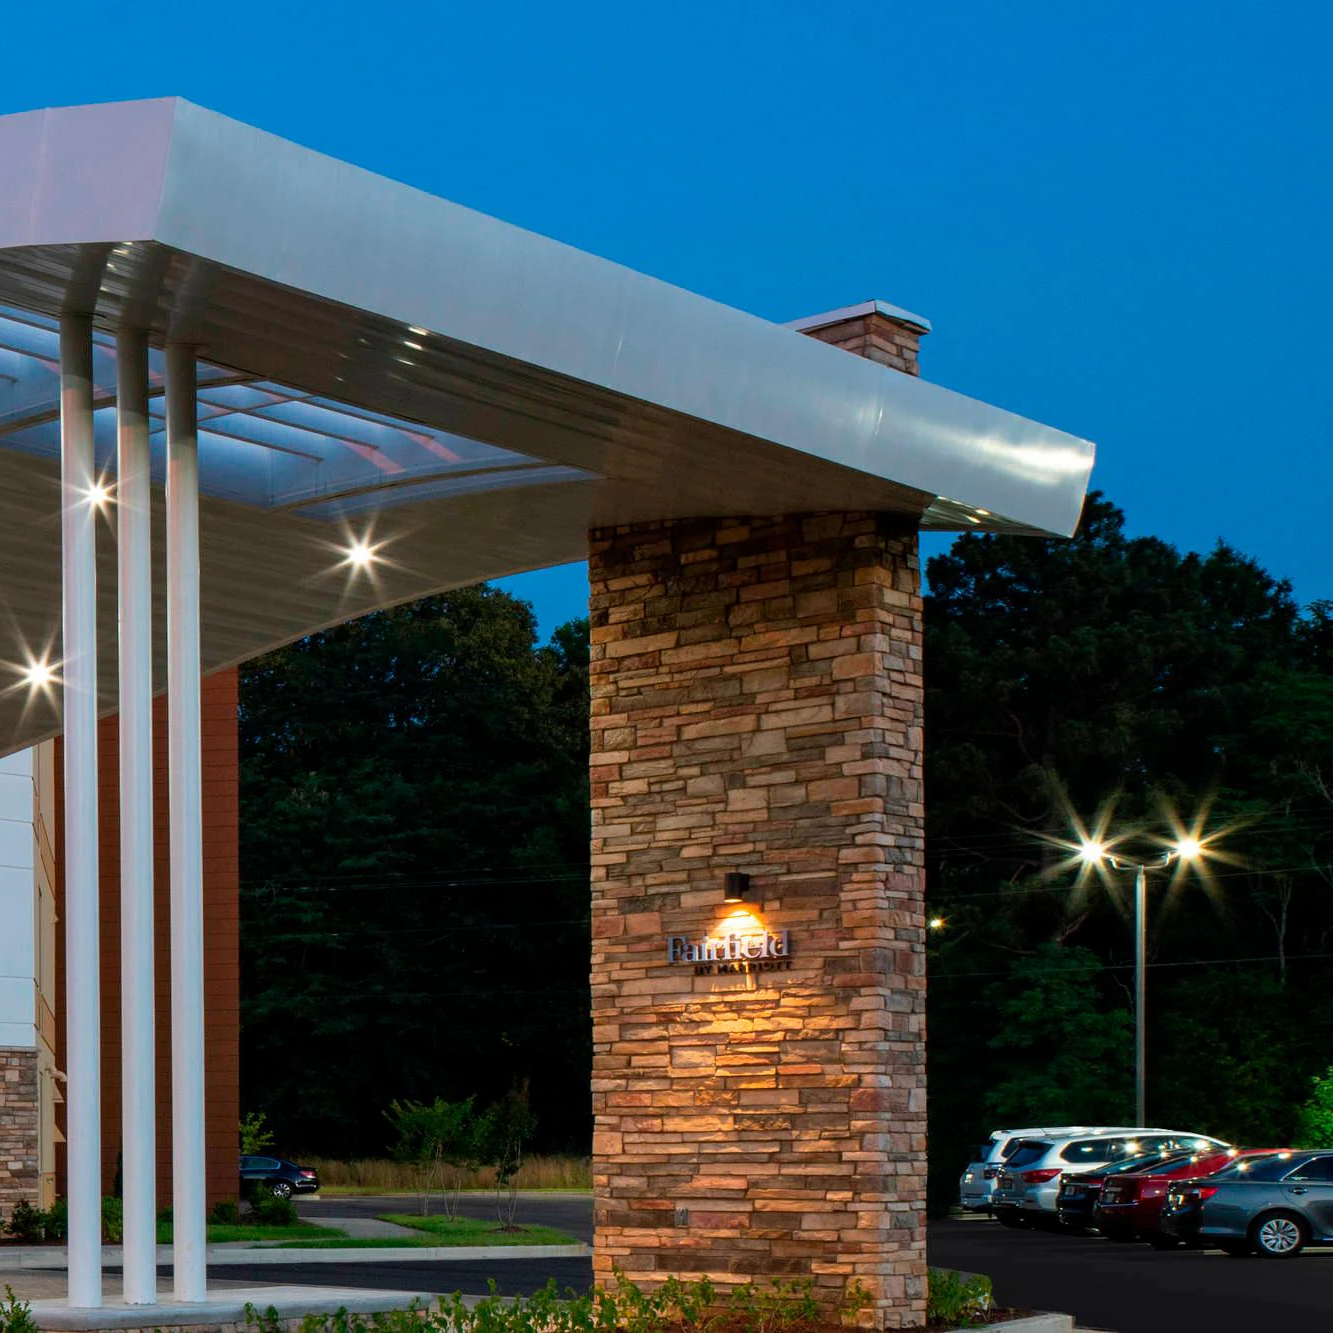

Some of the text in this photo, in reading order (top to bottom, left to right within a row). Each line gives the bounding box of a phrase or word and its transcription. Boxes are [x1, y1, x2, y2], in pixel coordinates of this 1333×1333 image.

[667, 930, 790, 963] Fairfield
[694, 960, 793, 975] BY MARRIOTT
